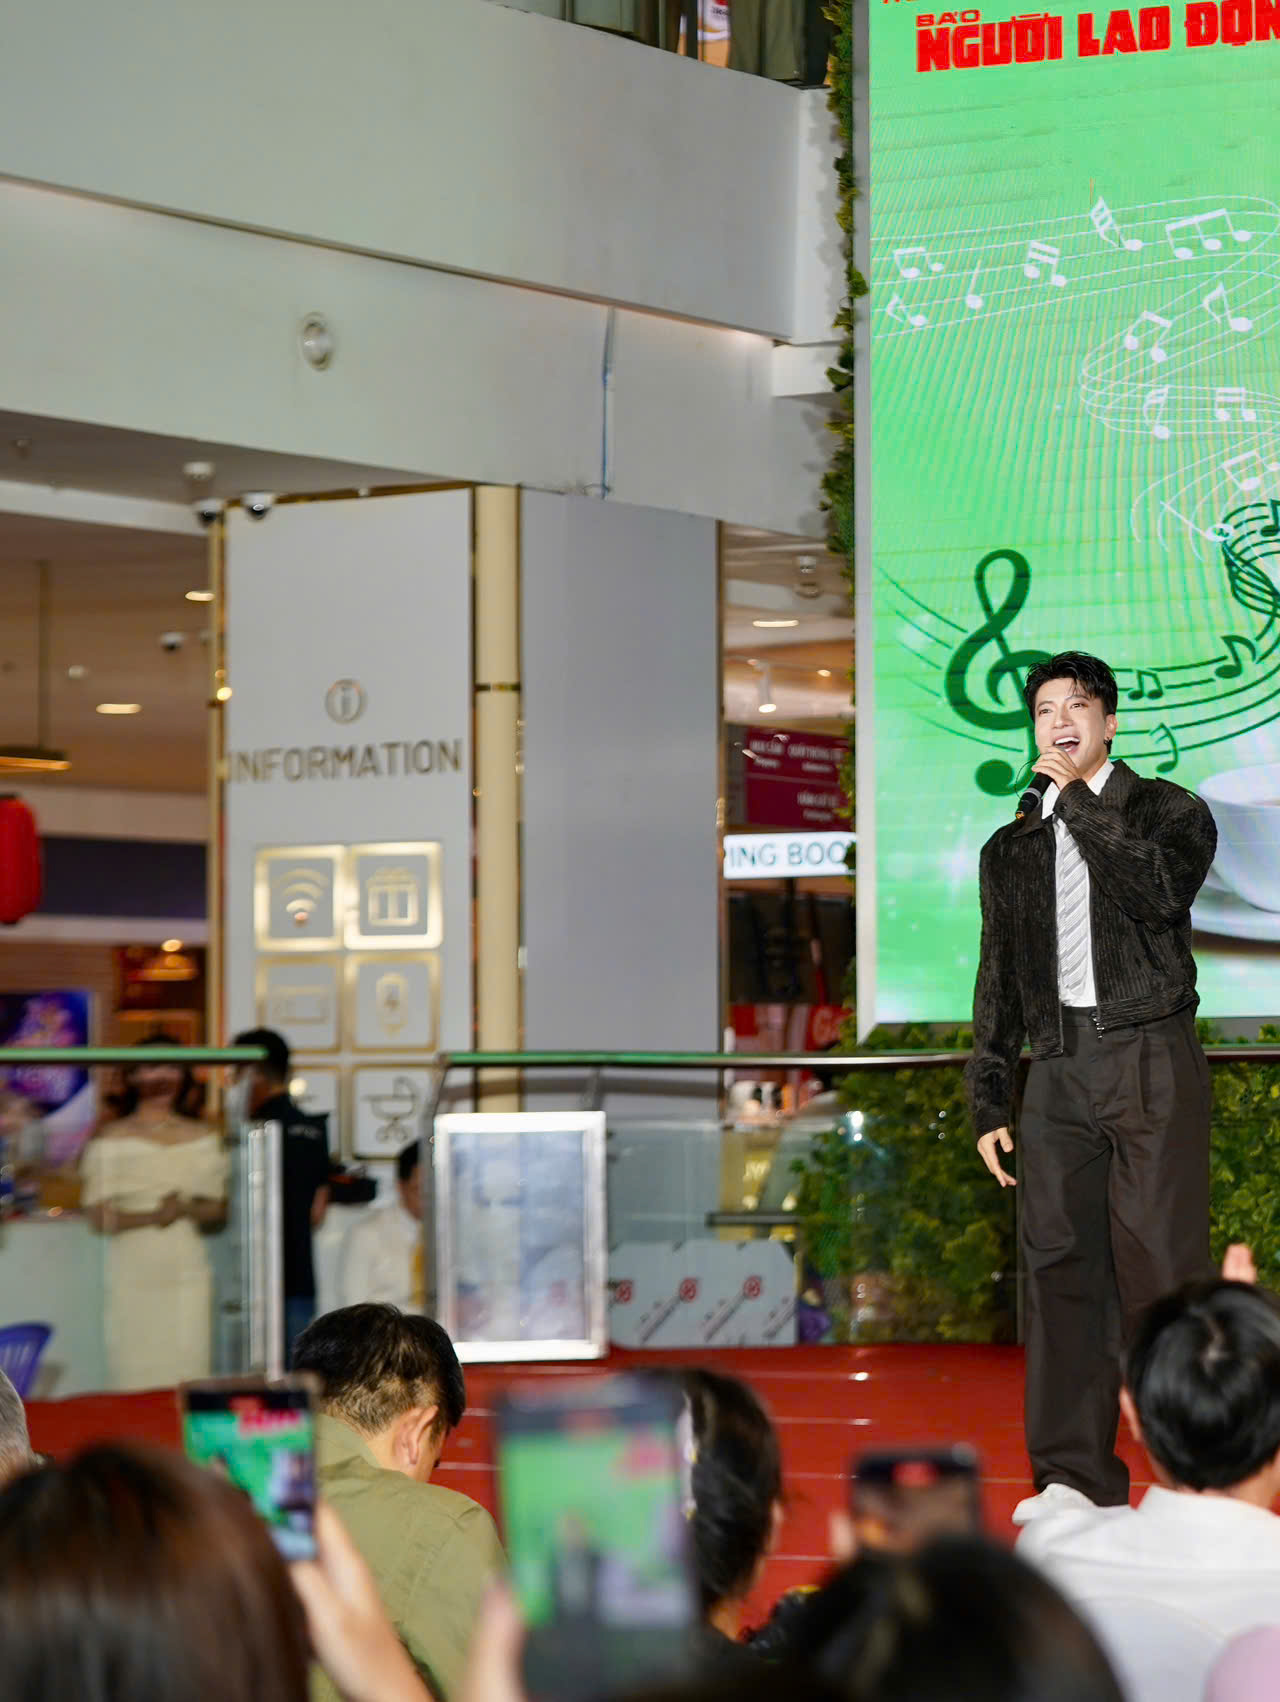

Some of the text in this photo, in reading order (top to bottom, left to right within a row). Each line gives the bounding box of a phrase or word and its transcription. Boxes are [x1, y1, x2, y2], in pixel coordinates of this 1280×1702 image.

[916, 12, 1063, 72] NGƯỜI
[1077, 6, 1171, 57] LAO
[224, 738, 462, 784] INFORMATION
